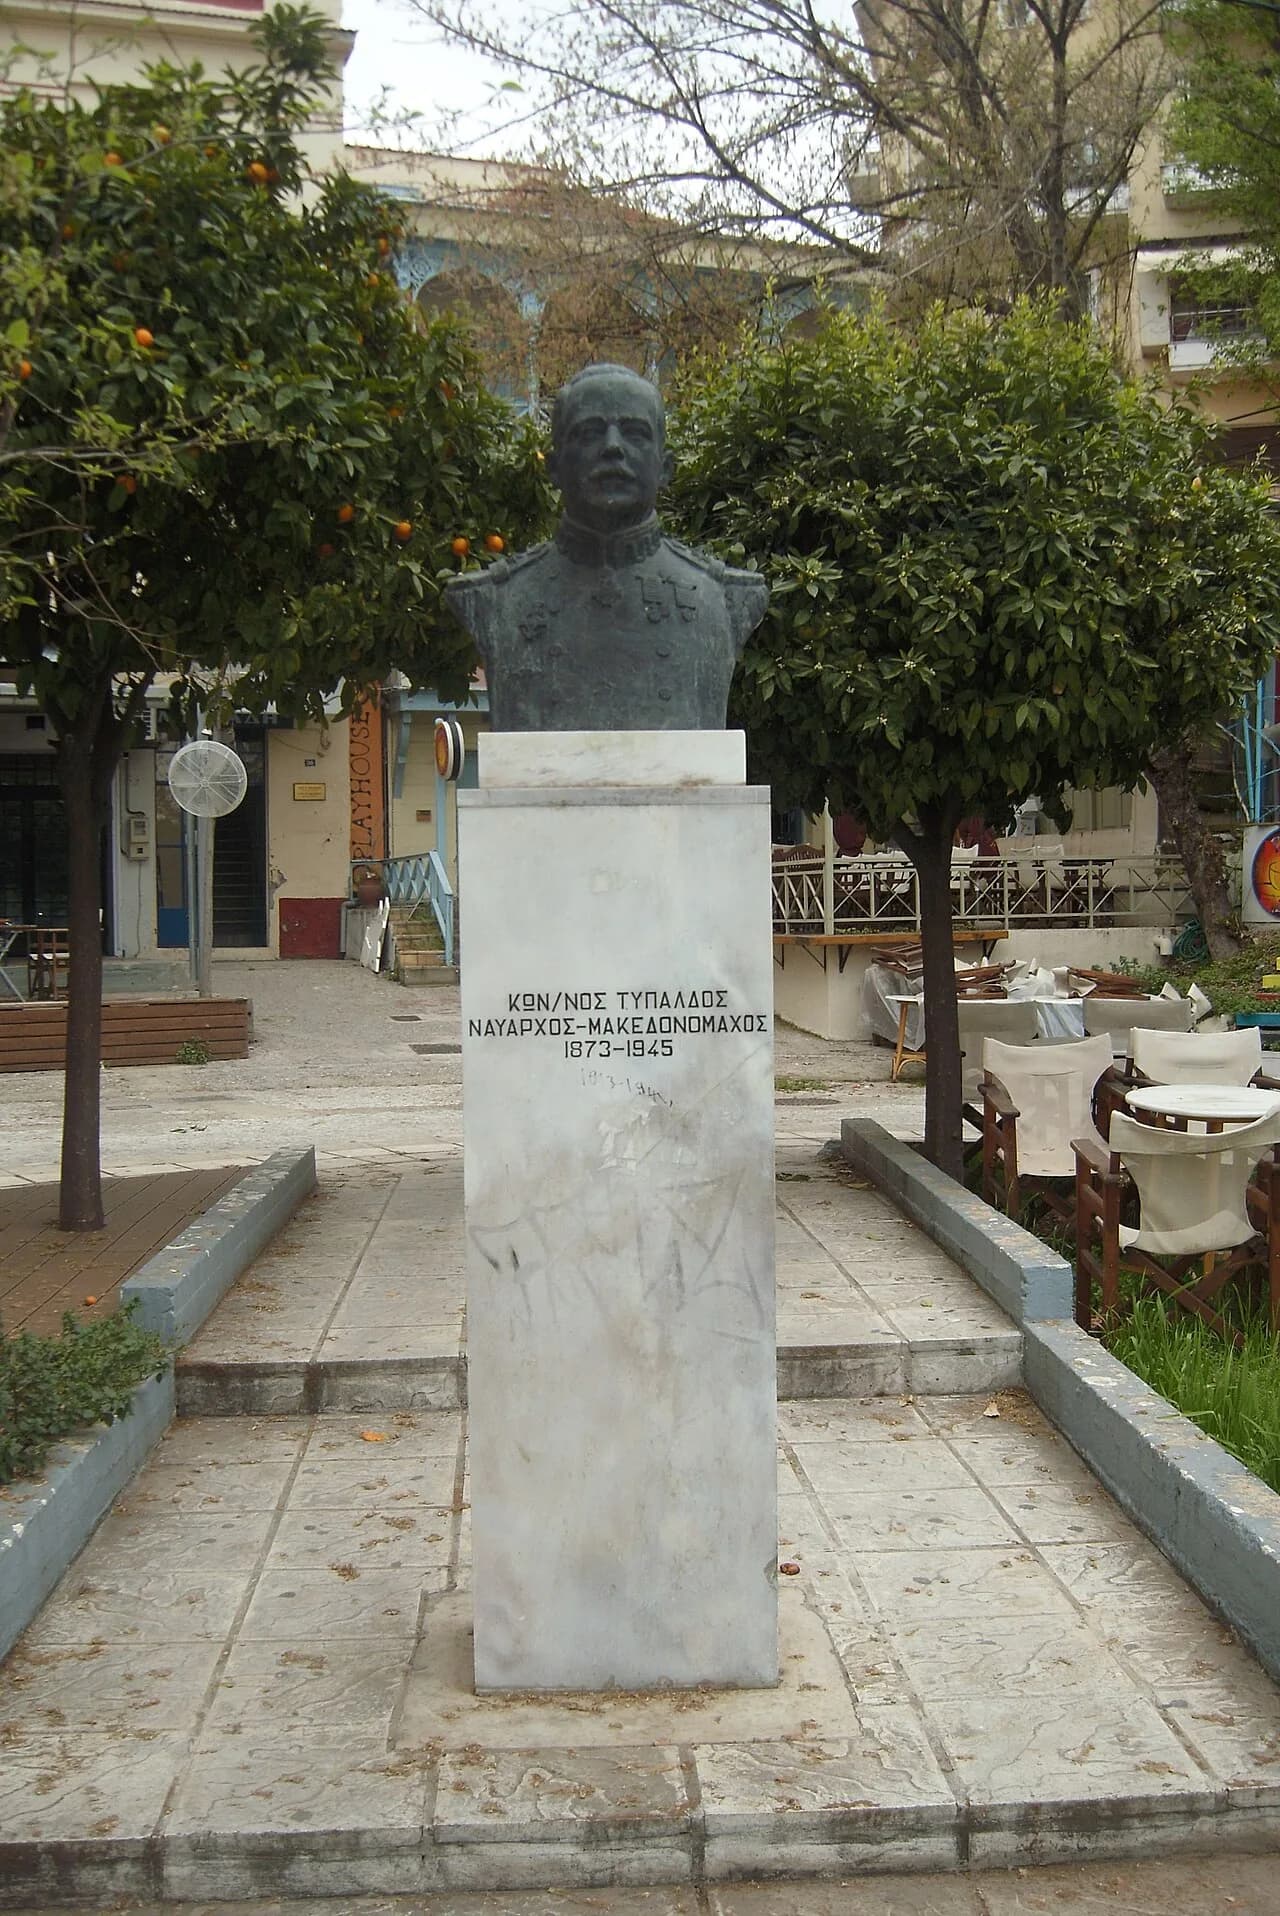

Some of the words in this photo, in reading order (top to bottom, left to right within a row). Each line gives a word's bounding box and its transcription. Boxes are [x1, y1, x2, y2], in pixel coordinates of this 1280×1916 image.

[507, 991, 607, 1012] ΚΩΝ/ΝΟΣ
[616, 990, 729, 1010] ΤΥΠΑΛΔΟΣ
[468, 1014, 768, 1037] ΝΑΥΑΡΧΟΣ-ΜΑΚΕΔΟΝΟΜΑΧΟΣ
[564, 1039, 673, 1059] 1873-1945
